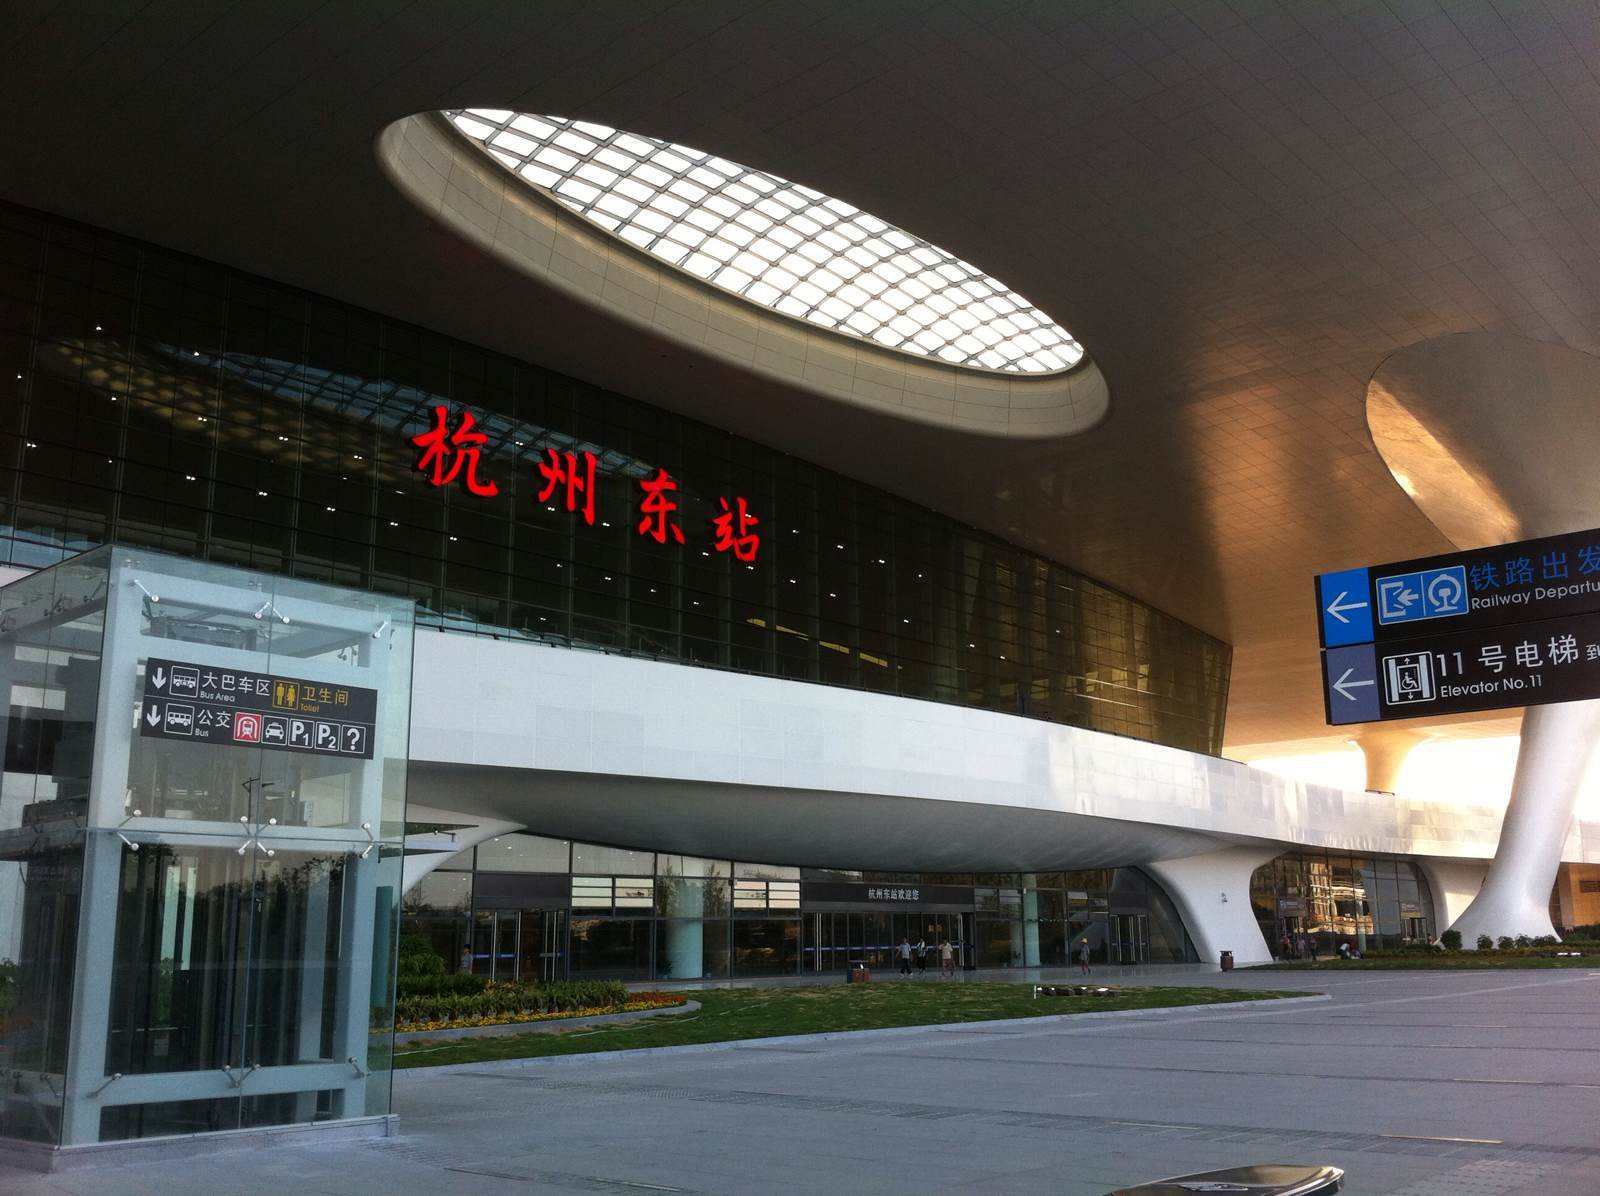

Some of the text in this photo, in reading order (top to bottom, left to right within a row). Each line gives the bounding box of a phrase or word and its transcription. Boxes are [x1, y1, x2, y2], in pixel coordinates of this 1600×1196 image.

[412, 405, 760, 561] 杭州东站
[1470, 545, 1600, 591] 铁路出发
[1471, 591, 1531, 609] Railway
[202, 671, 270, 697] 大巴车区
[1440, 674, 1542, 698] Elevator No.11
[200, 690, 235, 702] Bus Area
[302, 686, 349, 706] 卫生间
[197, 709, 231, 728] 公交
[195, 728, 209, 737] Bus
